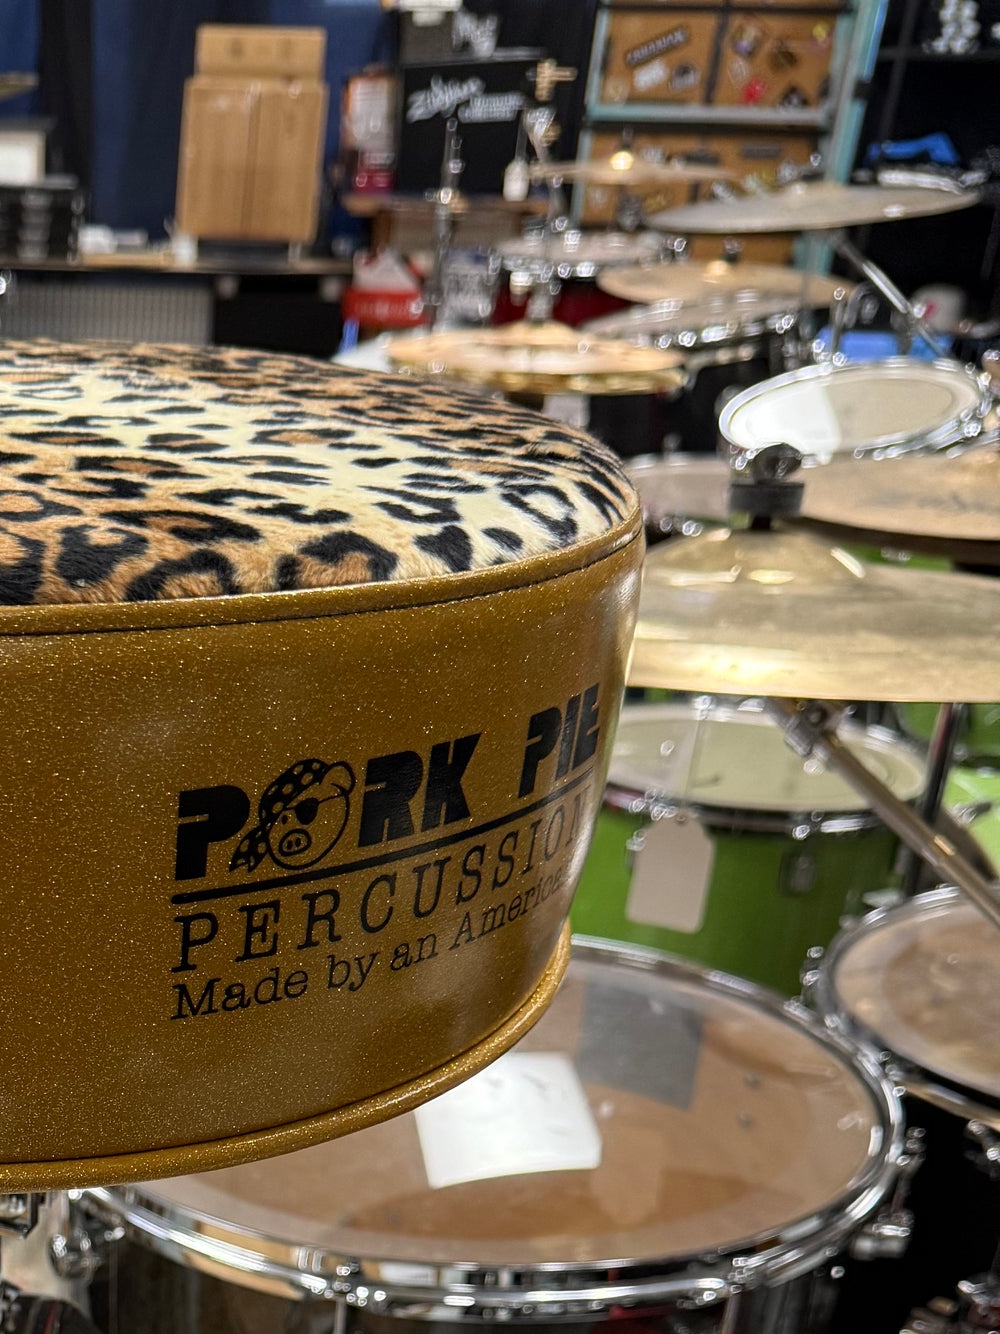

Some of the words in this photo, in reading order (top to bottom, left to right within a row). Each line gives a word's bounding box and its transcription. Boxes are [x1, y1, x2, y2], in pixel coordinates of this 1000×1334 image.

[175, 732, 482, 880] PORK
[517, 683, 600, 799] PIE
[171, 785, 591, 973] PERCUSSION
[171, 967, 309, 1020] Made
[327, 952, 380, 992] by
[390, 931, 438, 972] an
[449, 867, 565, 953] America
